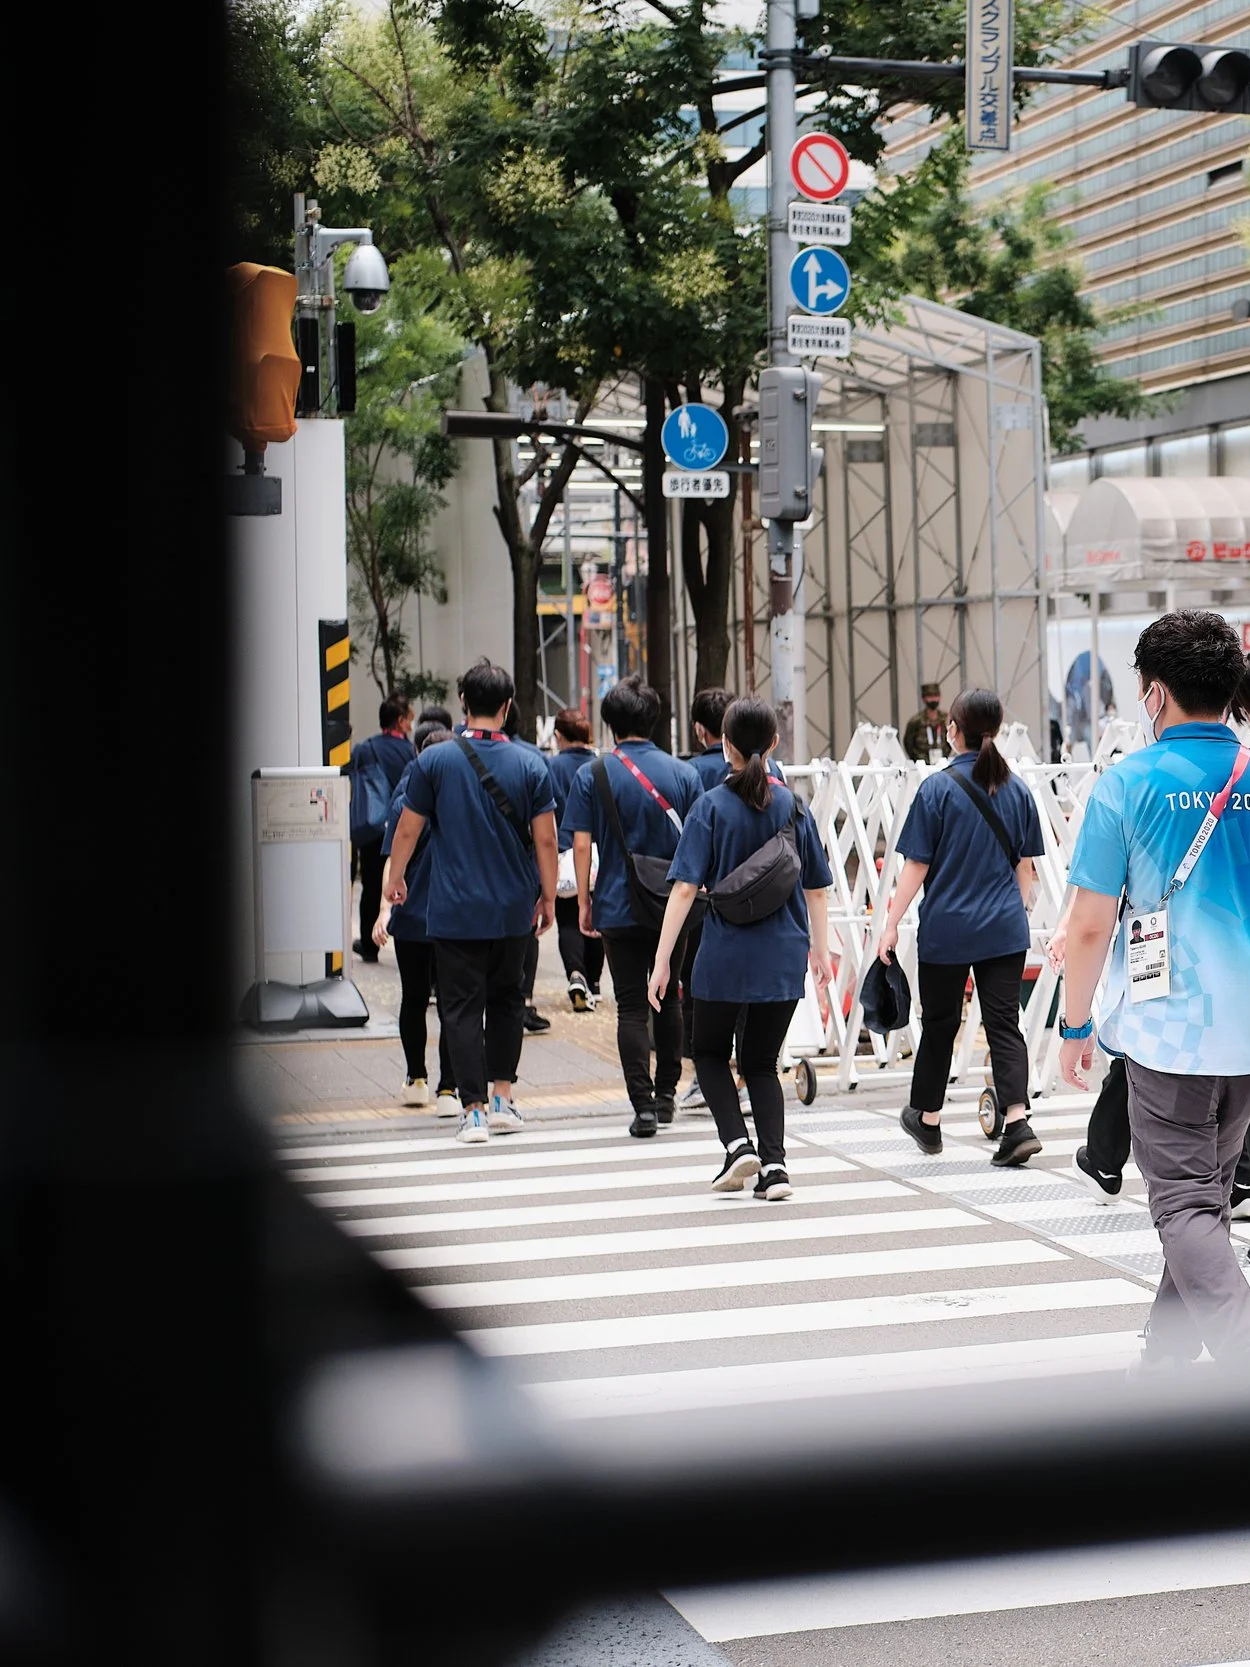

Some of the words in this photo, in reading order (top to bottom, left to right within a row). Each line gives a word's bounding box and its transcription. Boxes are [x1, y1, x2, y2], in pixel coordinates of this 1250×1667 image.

[1165, 791, 1227, 811] TOKY
[1189, 834, 1206, 858] TOKYO
[1201, 817, 1215, 836] 2020
